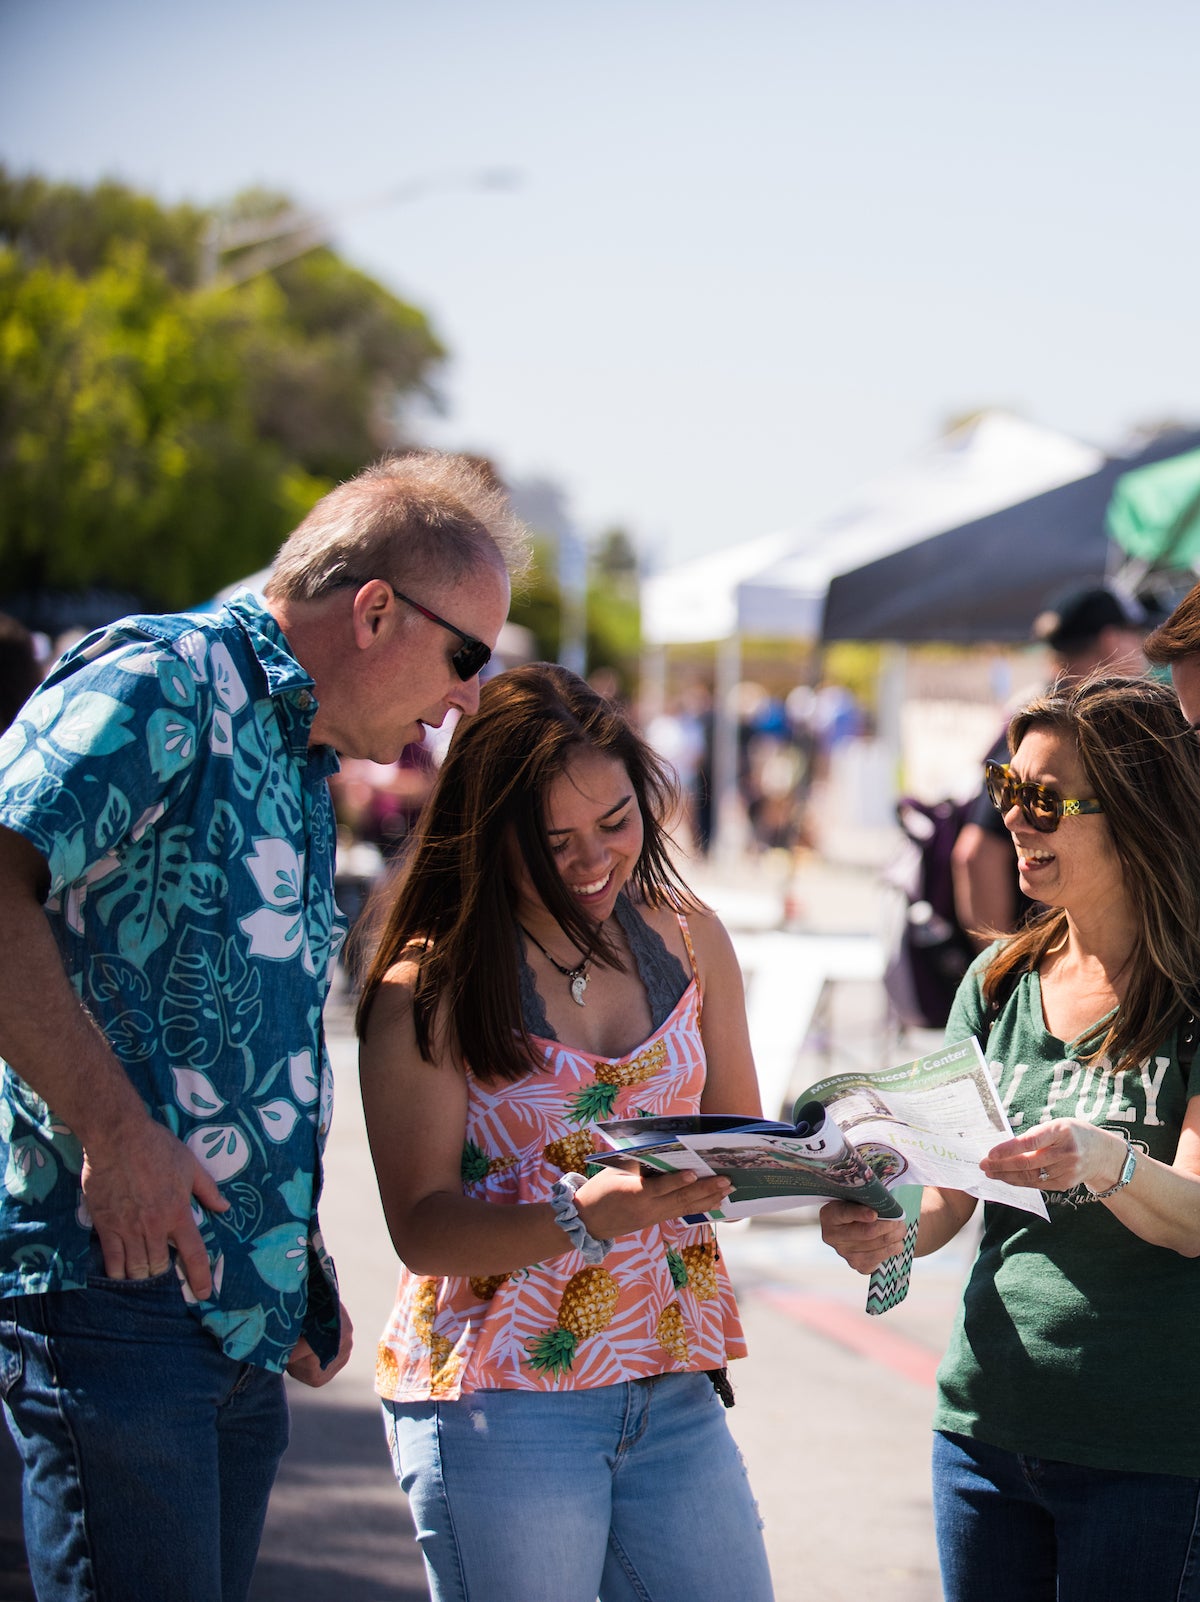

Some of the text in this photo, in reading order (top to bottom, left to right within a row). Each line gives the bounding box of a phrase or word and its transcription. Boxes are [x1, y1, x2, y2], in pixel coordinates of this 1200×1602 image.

[810, 1074, 868, 1095] Mustang
[869, 1067, 920, 1083] Success
[922, 1047, 968, 1071] Center
